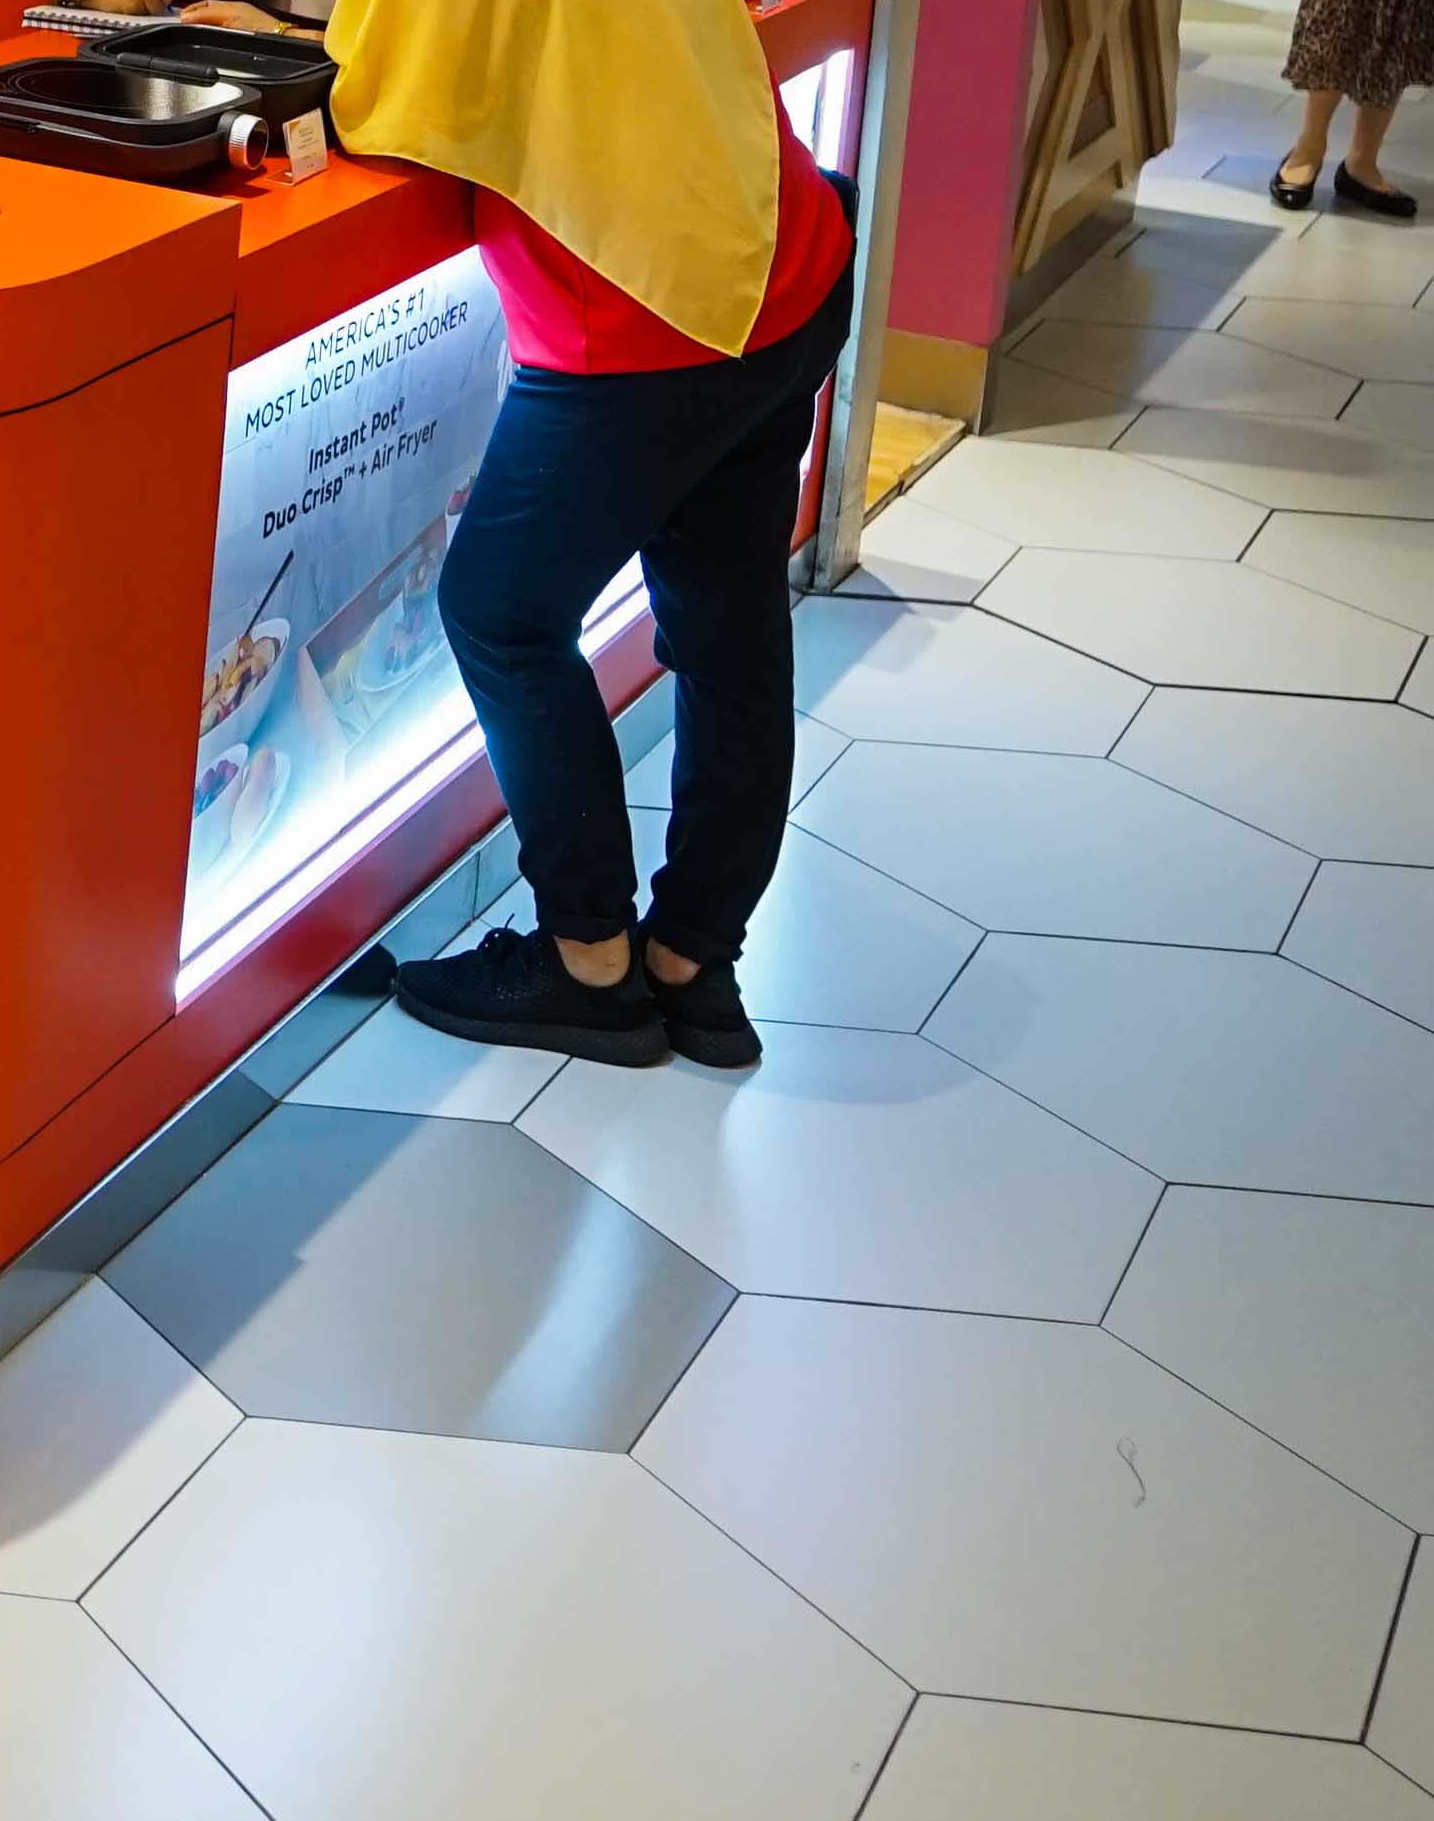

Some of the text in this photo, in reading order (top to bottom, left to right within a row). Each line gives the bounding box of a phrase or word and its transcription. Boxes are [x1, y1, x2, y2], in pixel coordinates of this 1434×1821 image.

[245, 301, 469, 439] MOST LOVED MULTICOOKER
[305, 287, 425, 370] AMERICA'S #1
[262, 502, 297, 540] Duo
[370, 444, 394, 475] Air
[397, 419, 438, 458] Fryer
[307, 421, 367, 474] Instant
